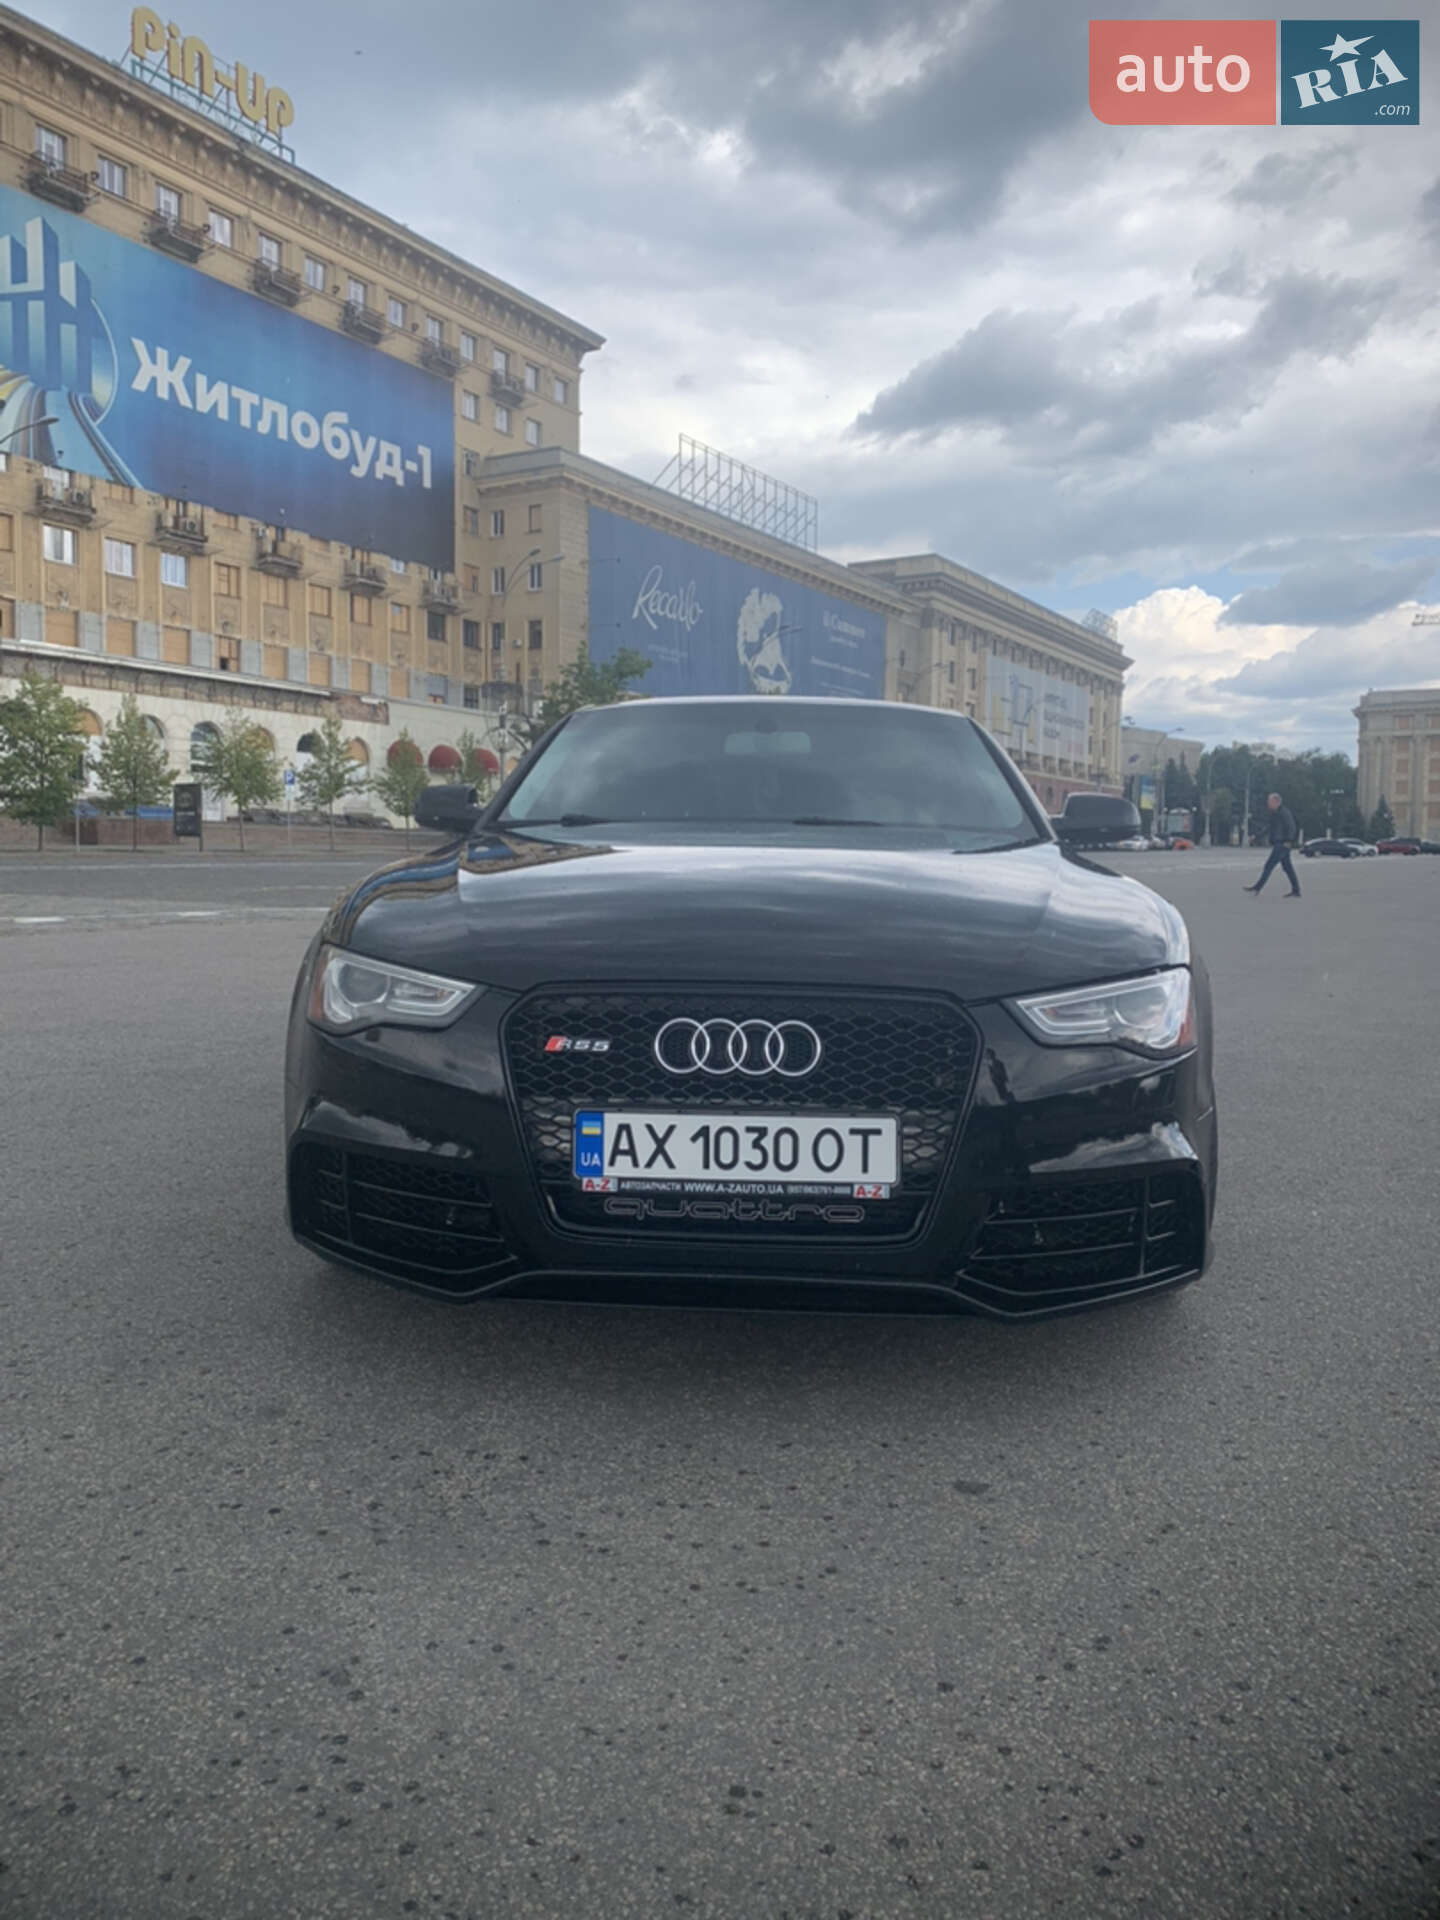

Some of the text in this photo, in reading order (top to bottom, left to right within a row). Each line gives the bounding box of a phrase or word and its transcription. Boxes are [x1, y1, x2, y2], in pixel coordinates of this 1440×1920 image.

[131, 336, 432, 489] Житлобуд-1
[607, 1123, 882, 1174] AX 1030 OT
[581, 1153, 602, 1167] UA
[584, 1178, 611, 1192] A-Z
[684, 1182, 785, 1194] WWW.A-ZAUTO.UA
[855, 1185, 883, 1199] A-Z
[604, 1197, 865, 1223] quattro
